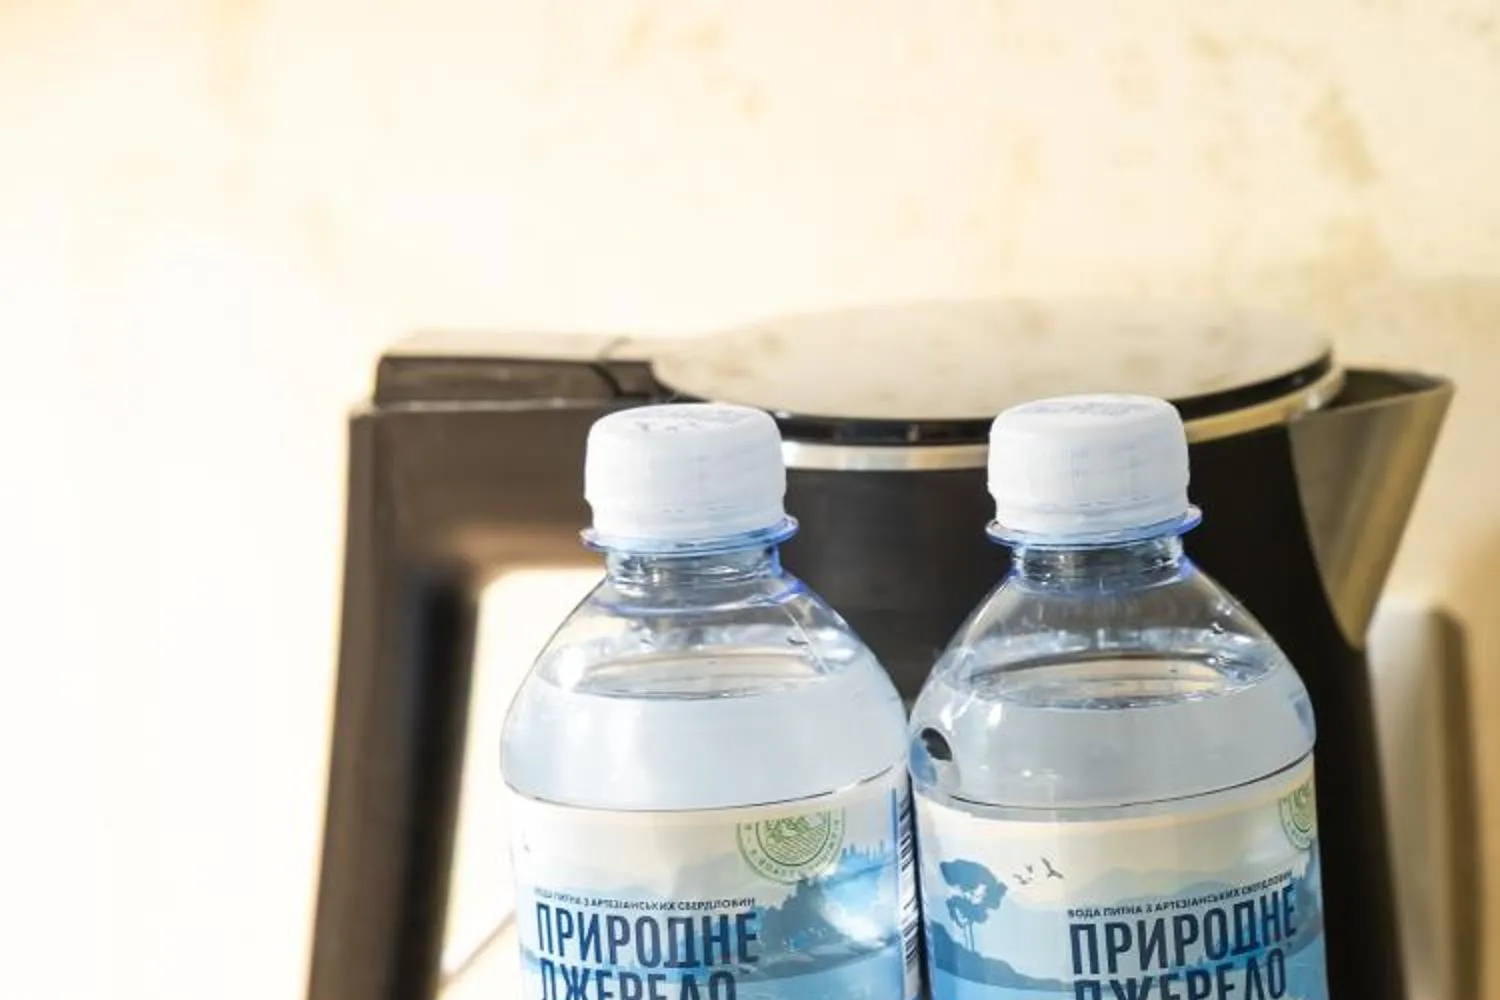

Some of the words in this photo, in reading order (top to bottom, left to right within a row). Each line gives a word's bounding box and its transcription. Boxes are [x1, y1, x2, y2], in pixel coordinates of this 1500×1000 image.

[535, 901, 759, 969] ПРИРОДНЕ
[1067, 908, 1100, 919] ВОДА
[1103, 905, 1142, 917] ПИТНА
[1069, 883, 1297, 975] ПРИРОДНЕ
